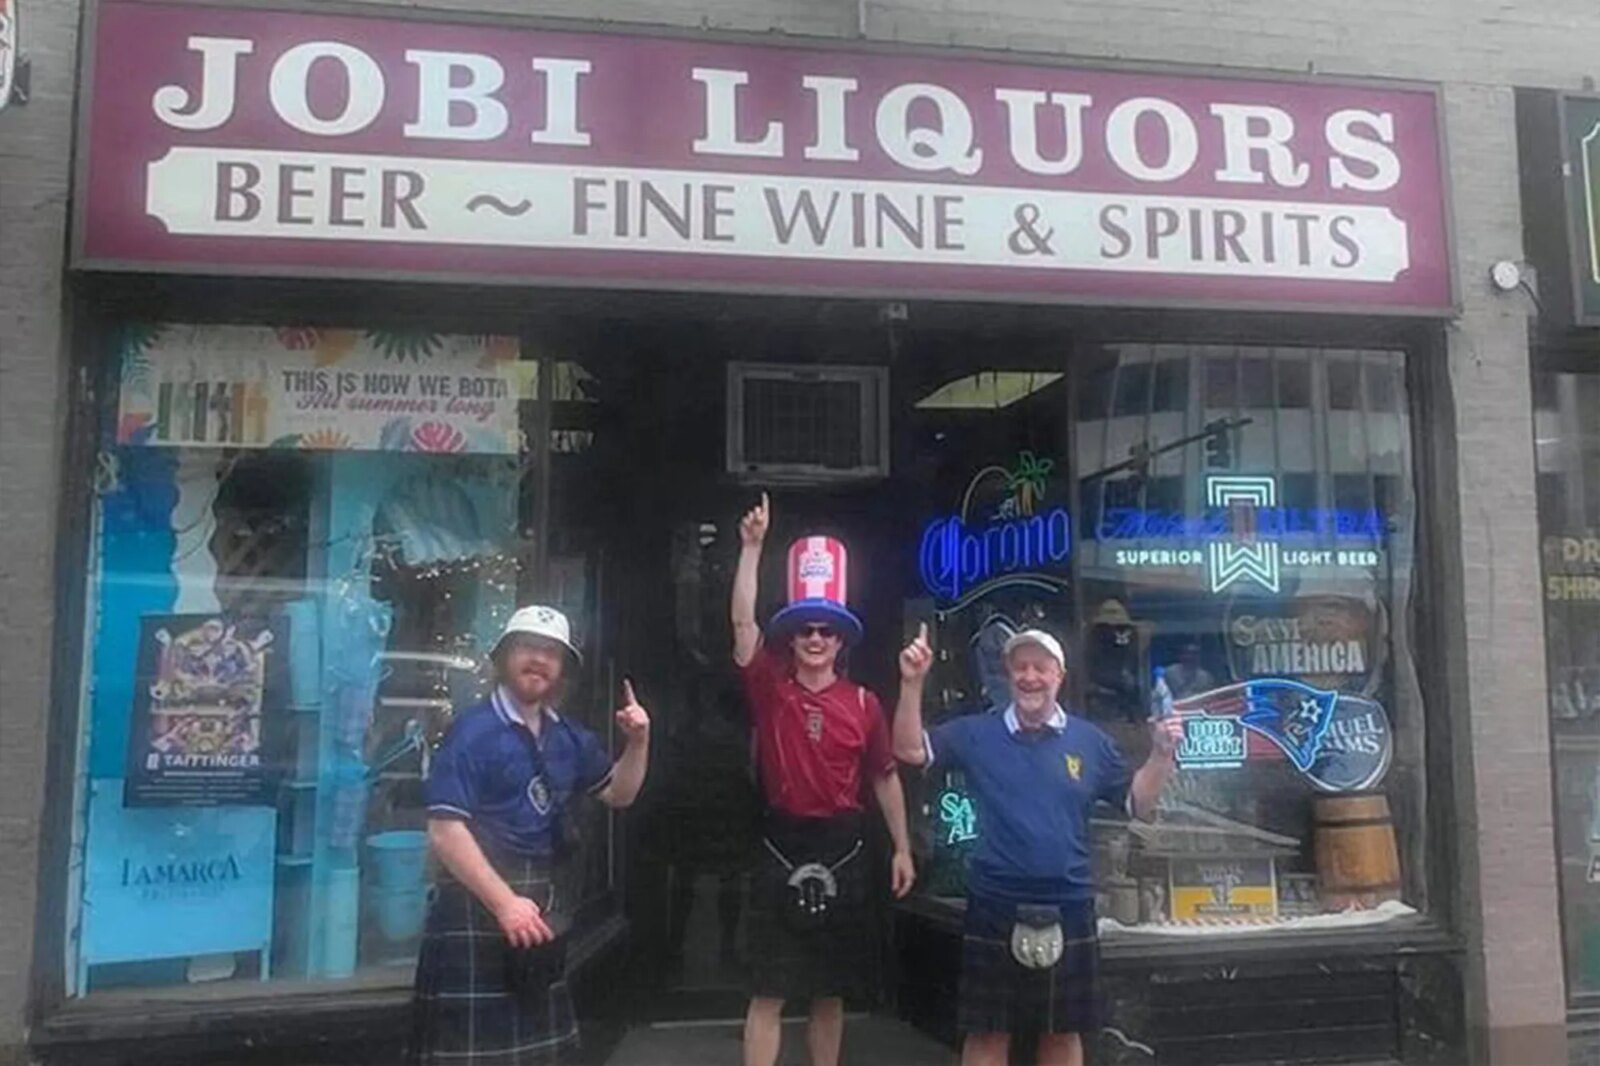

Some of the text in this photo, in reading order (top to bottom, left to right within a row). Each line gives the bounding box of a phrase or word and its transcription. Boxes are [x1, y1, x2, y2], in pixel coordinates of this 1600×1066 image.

[153, 36, 1400, 192] JOBI LIQUORS
[213, 160, 428, 230] BEER
[572, 177, 735, 243] FINE
[765, 187, 964, 252] WINE
[1007, 203, 1056, 256] &
[1100, 203, 1360, 268] SPIRITS
[282, 370, 330, 393] THIS
[336, 371, 358, 399] IS
[364, 373, 411, 396] HOW
[419, 374, 453, 397] WE
[347, 397, 439, 416] summer
[446, 396, 498, 422] long
[1116, 550, 1378, 566] SUPERIOR LIGHT BEER
[1252, 640, 1366, 673] AMERICA
[163, 753, 260, 768] TAITTINGER
